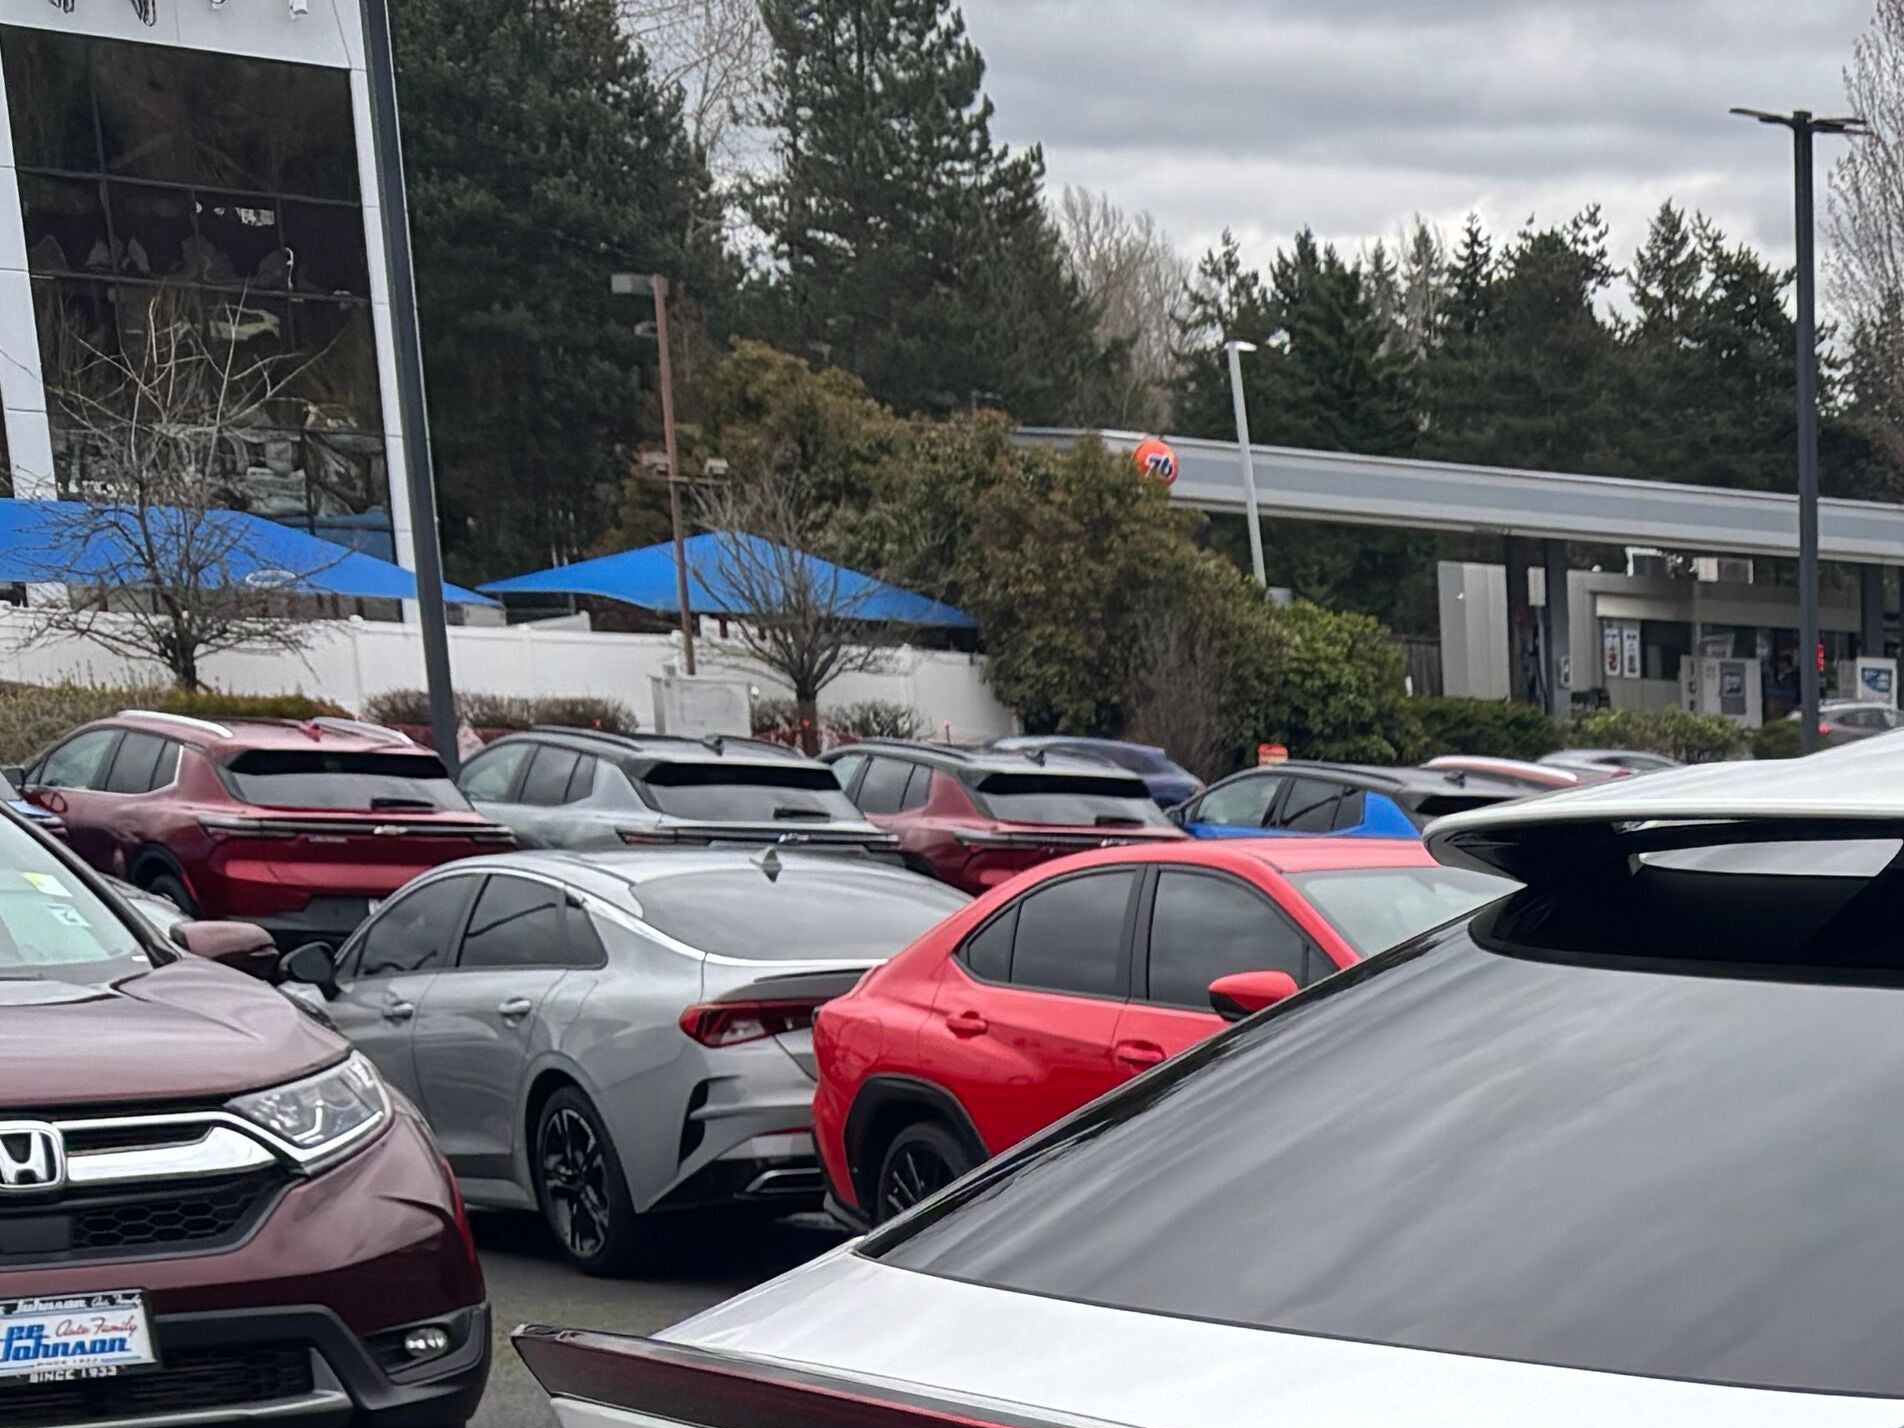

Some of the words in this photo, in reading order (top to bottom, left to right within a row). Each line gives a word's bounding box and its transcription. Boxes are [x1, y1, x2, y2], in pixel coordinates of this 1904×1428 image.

[55, 1318, 91, 1338] Auto
[90, 1314, 138, 1338] Family
[29, 1369, 75, 1384] SINCE
[81, 1365, 118, 1379] 1933
